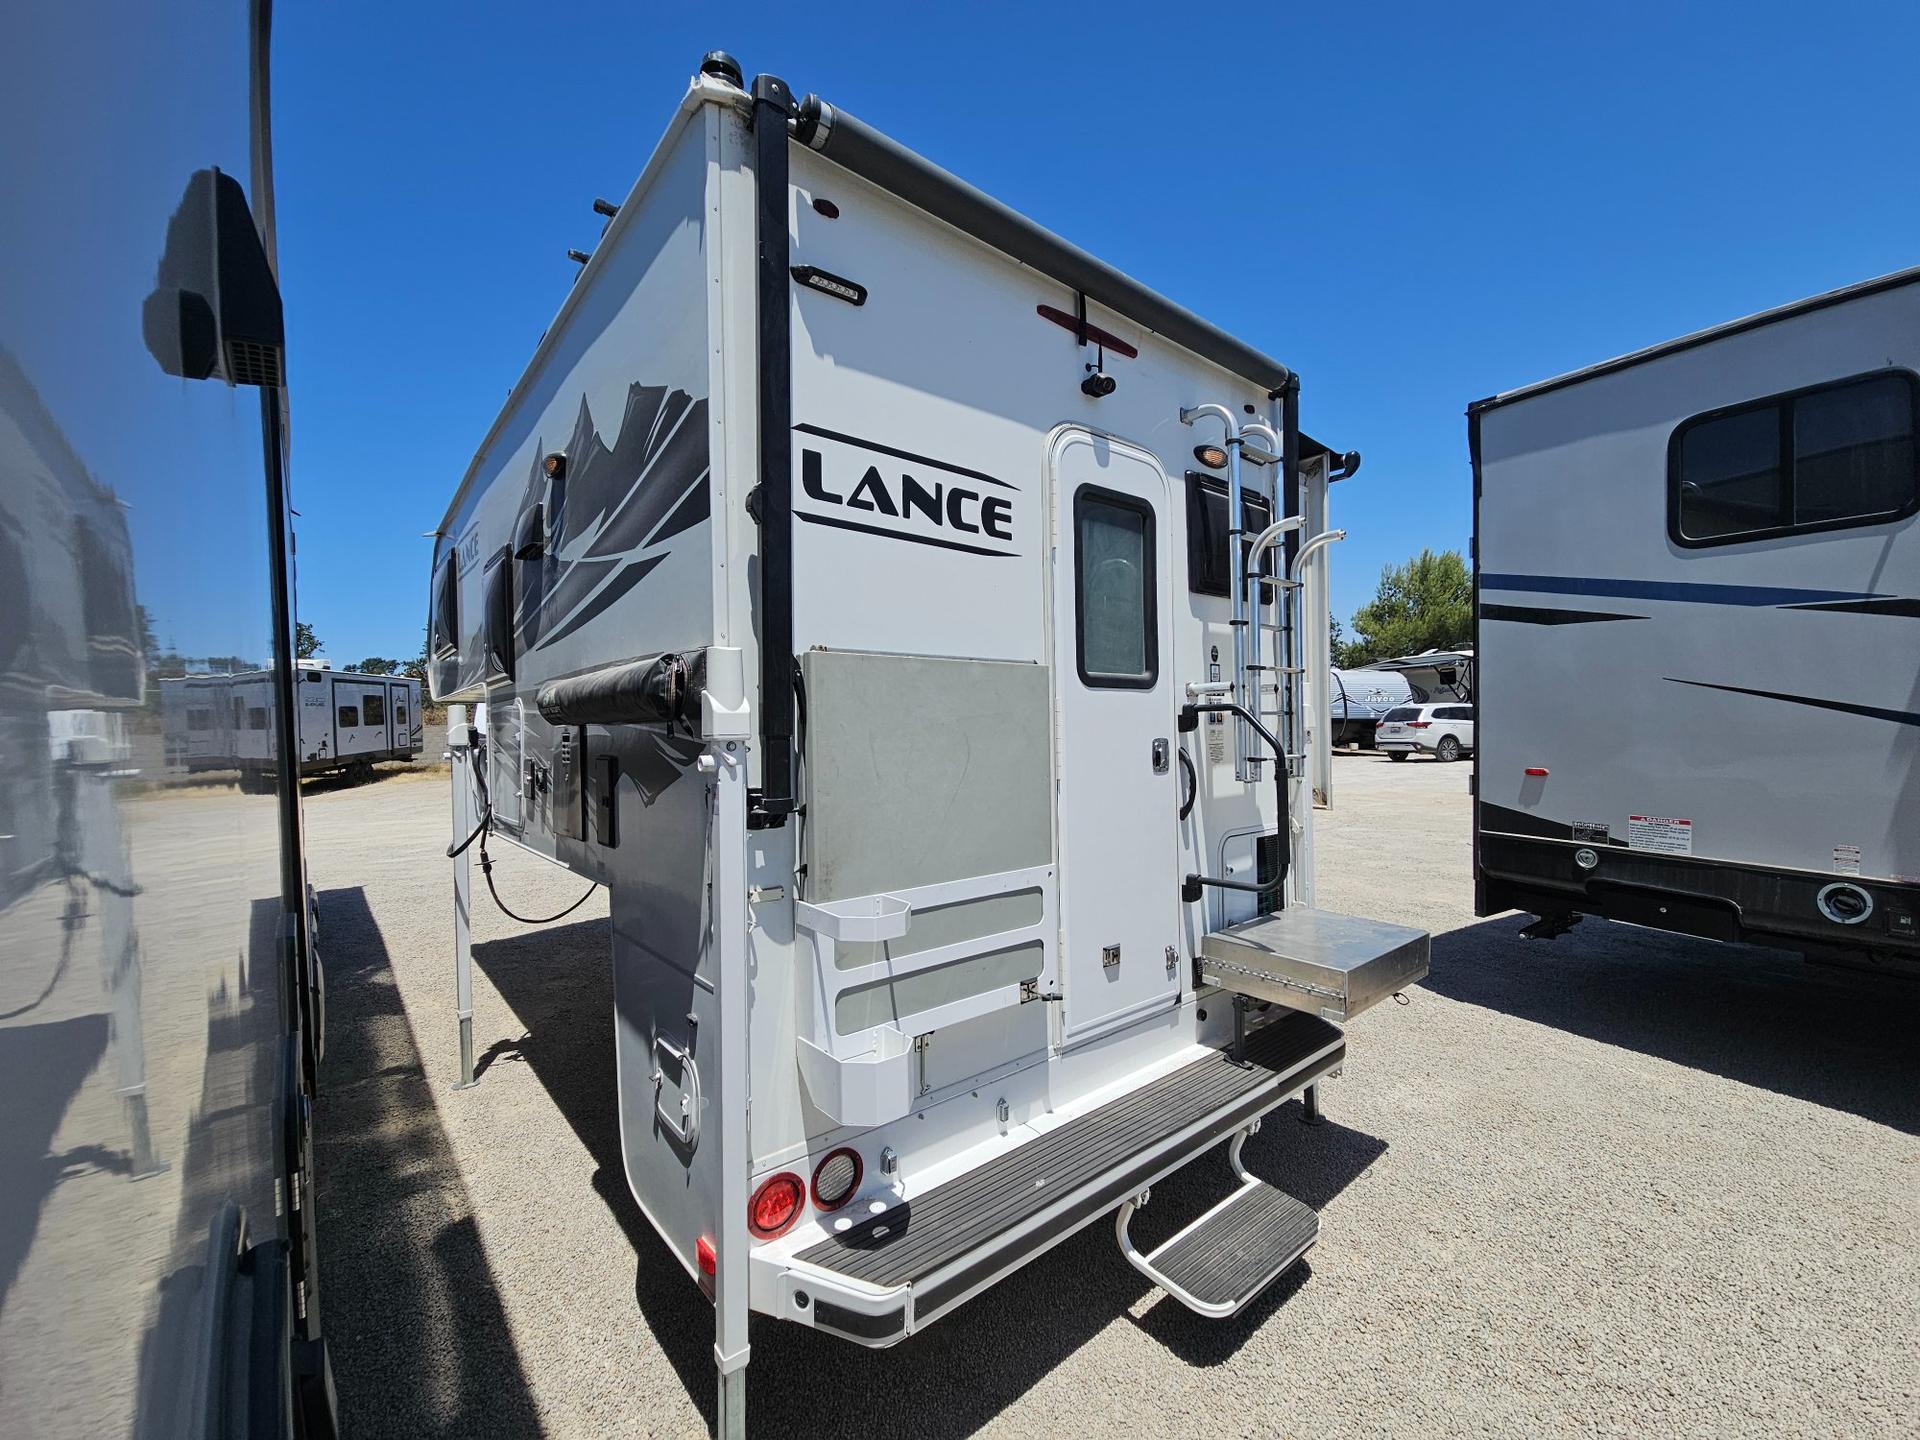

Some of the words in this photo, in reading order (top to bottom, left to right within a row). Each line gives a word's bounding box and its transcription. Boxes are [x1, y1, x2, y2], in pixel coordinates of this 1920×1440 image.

[802, 448, 1012, 541] LANCE
[458, 532, 479, 573] LANCE
[1365, 695, 1395, 703] Jayco
